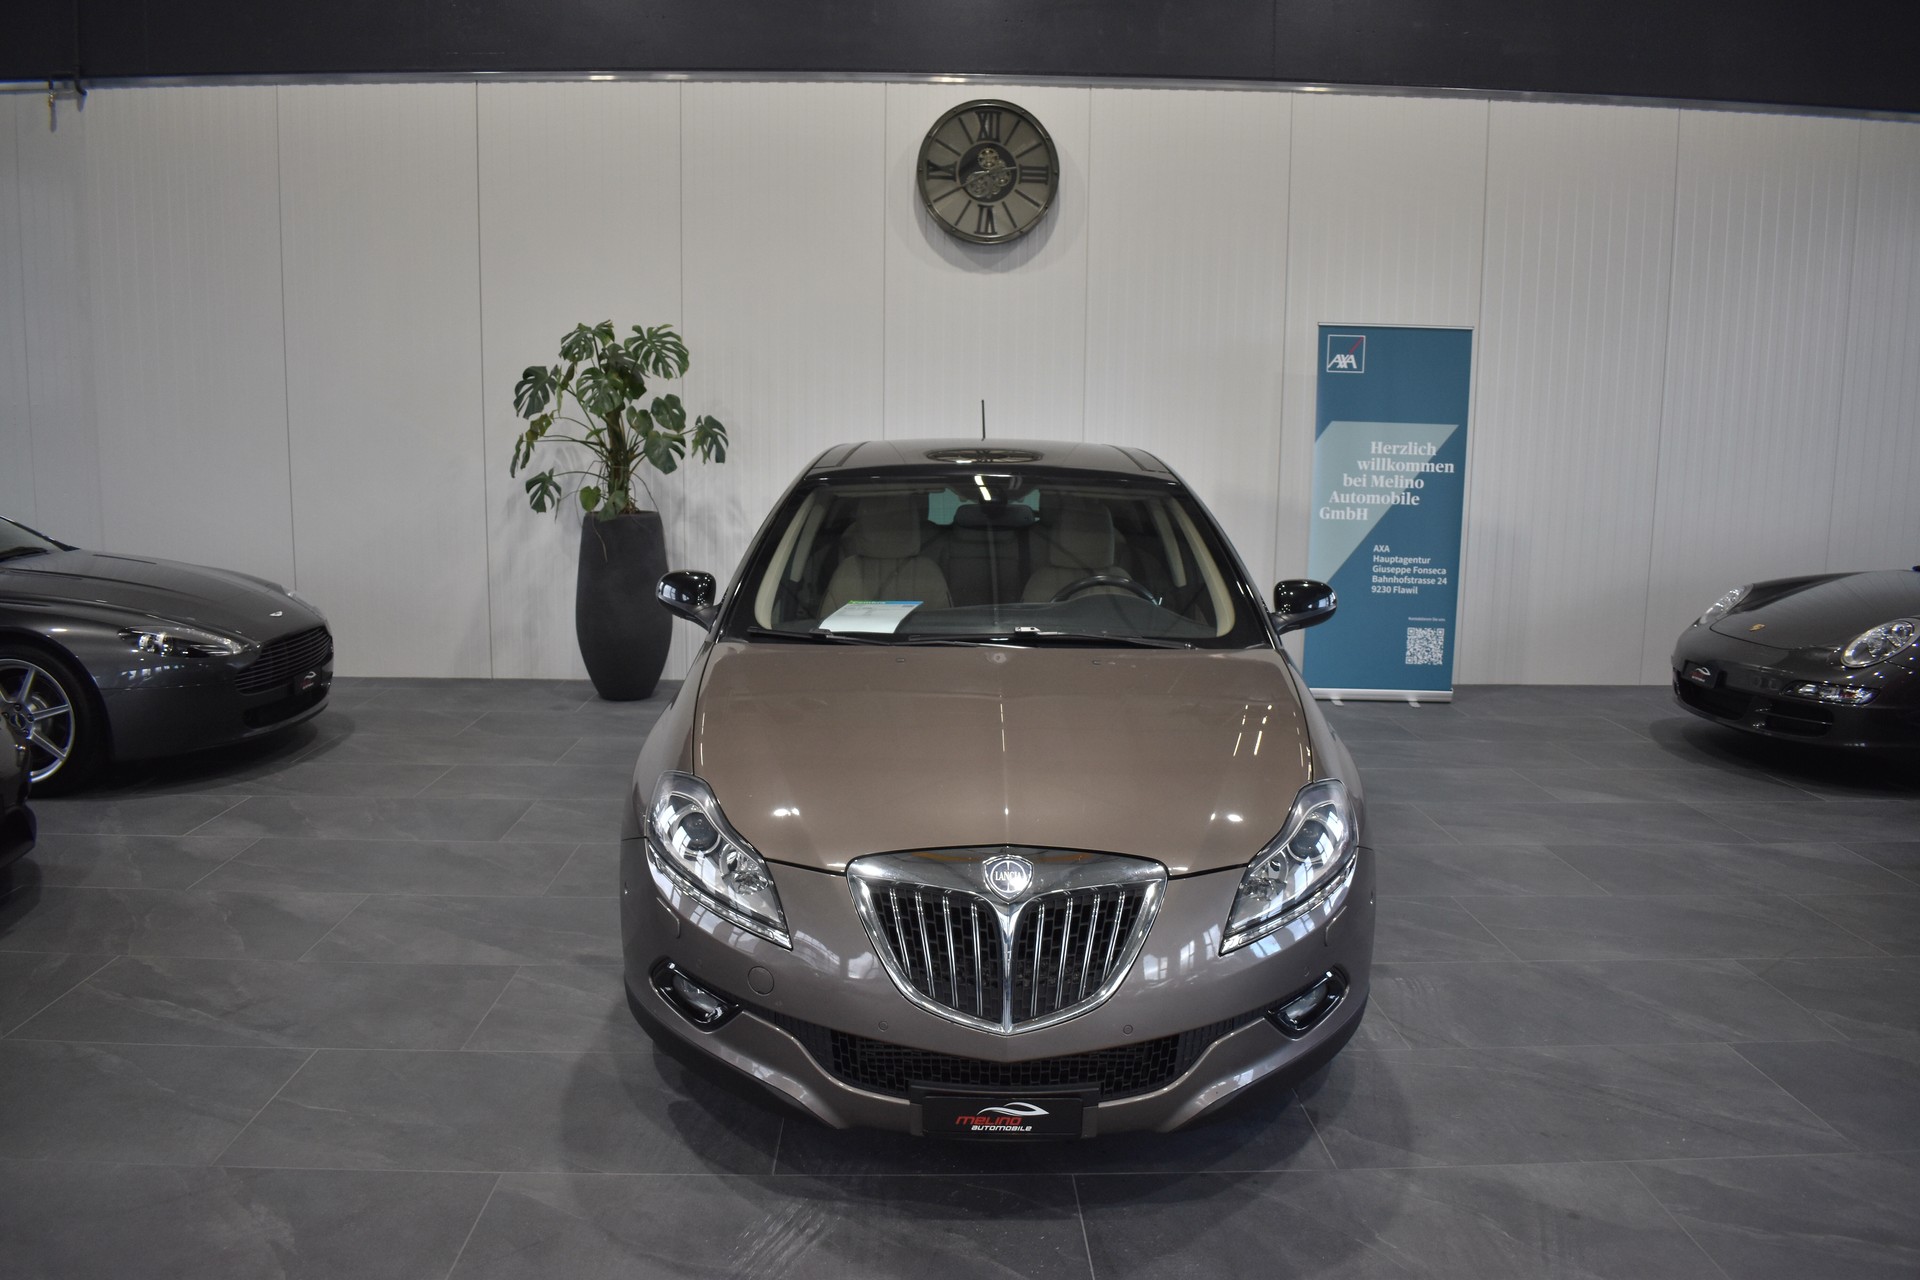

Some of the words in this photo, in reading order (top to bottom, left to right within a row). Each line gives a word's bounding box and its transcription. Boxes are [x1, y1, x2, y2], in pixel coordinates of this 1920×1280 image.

[975, 110, 1001, 142] XII
[1019, 165, 1049, 185] III
[1328, 354, 1357, 369] AXA
[1371, 441, 1437, 456] Herzlich
[1357, 458, 1455, 473] willkommen
[1343, 473, 1366, 487] bei
[1370, 475, 1424, 489] Melino
[1329, 491, 1420, 506] Automobile
[1319, 507, 1368, 521] GmbH
[1373, 545, 1390, 553] AXA
[1373, 555, 1431, 565] Hauptagentur
[1372, 565, 1411, 575] Giuseppe
[1413, 567, 1447, 575] Fonseca
[1372, 575, 1435, 585] Bahnhofstrasse
